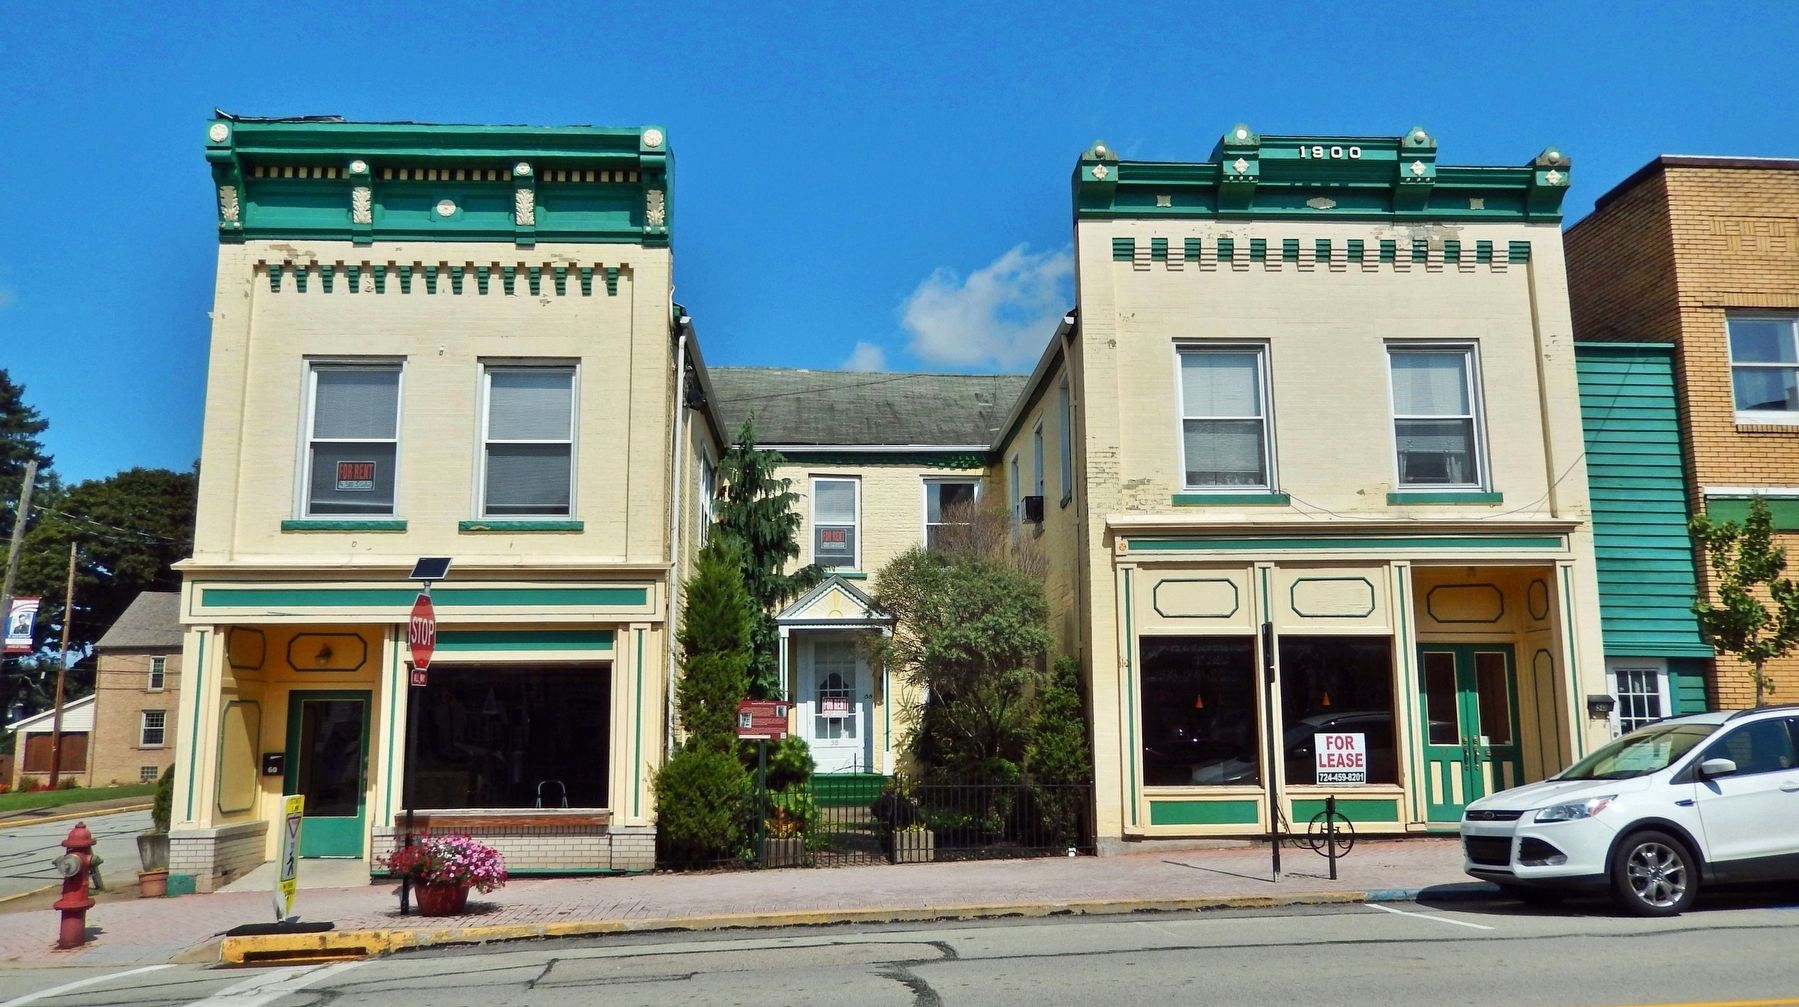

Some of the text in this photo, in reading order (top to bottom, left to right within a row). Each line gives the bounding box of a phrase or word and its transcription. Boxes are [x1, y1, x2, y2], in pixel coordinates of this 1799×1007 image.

[1300, 145, 1361, 159] 1900
[339, 463, 374, 480] FOR RENT
[411, 616, 435, 646] STOP
[824, 698, 847, 710] FOR RENT
[1325, 735, 1355, 750] FOR
[1318, 753, 1364, 768] LEASE
[267, 766, 278, 774] 60
[1319, 773, 1364, 782] 724-459-8201
